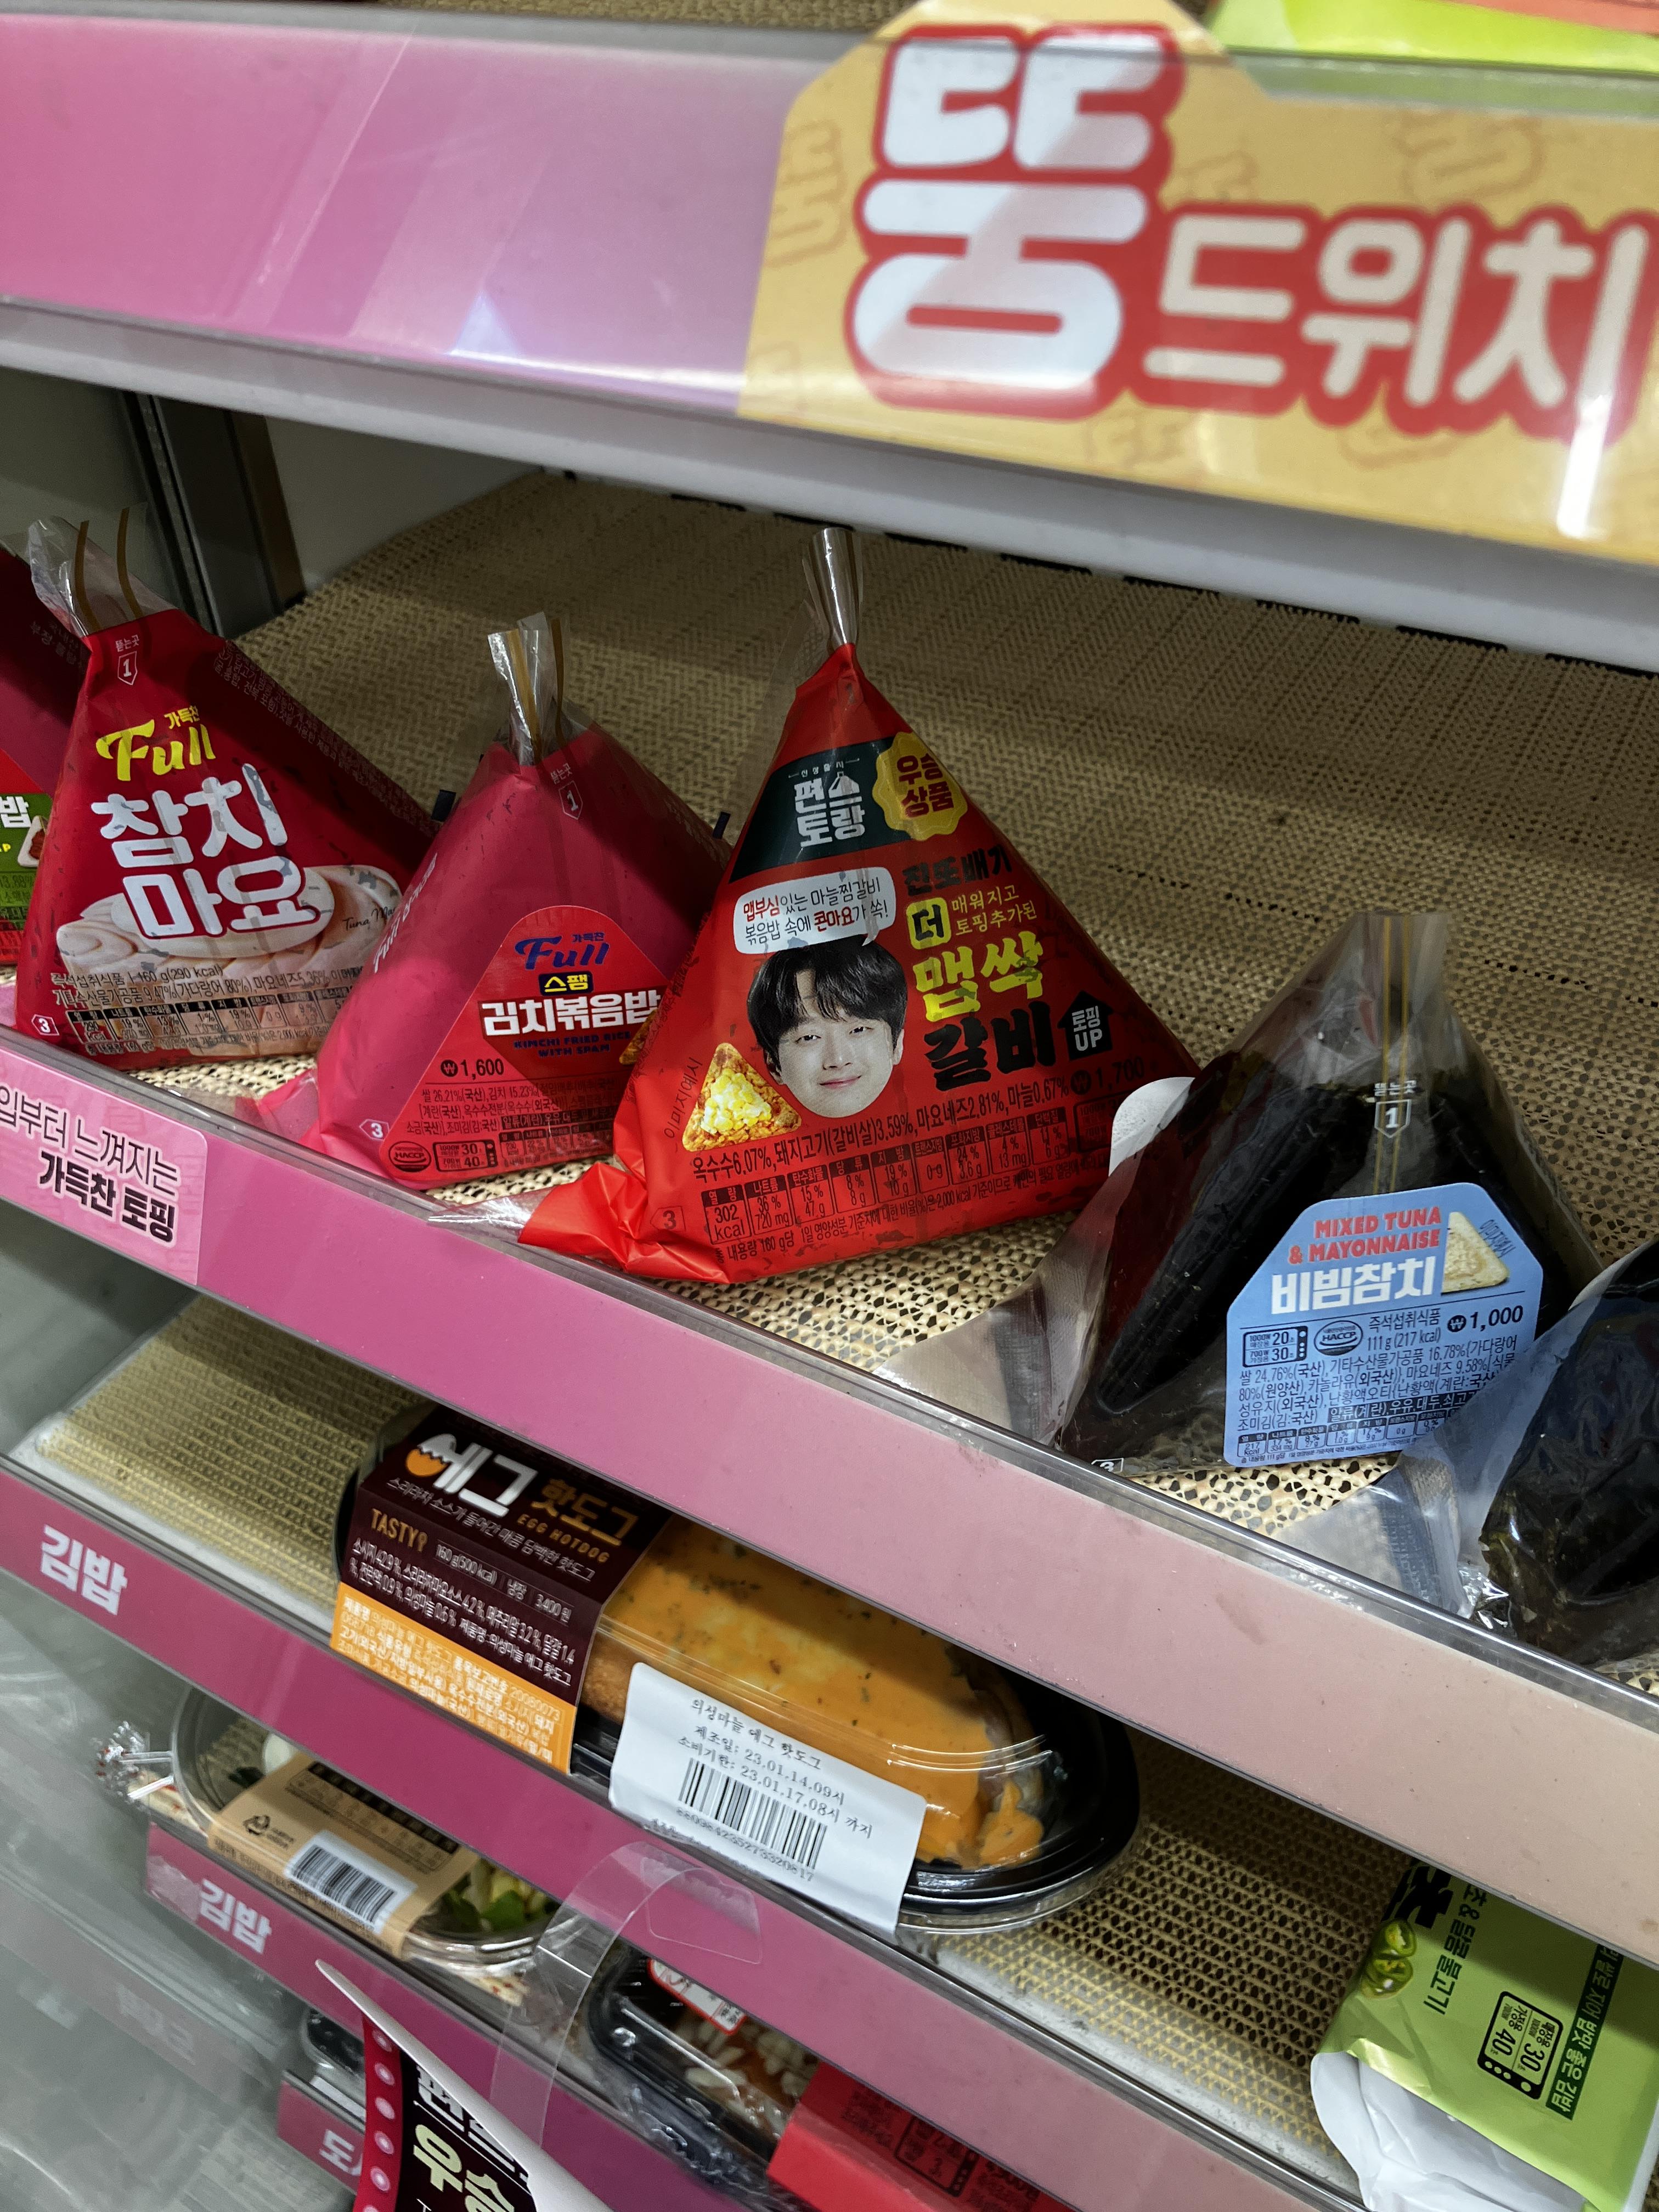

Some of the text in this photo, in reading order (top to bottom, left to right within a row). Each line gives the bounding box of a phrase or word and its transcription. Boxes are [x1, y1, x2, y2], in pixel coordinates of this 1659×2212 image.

[852, 32, 1647, 407] 뚱드위치
[115, 634, 139, 652] 뜯는곳
[123, 659, 132, 677] 1
[165, 706, 200, 729] 가득찬
[96, 719, 216, 782] Full
[0, 796, 32, 828] 밥
[91, 763, 288, 868] 참치
[567, 790, 579, 812] 1
[901, 782, 956, 819] 상품
[123, 855, 315, 935] 마요
[810, 877, 881, 906] 마늘찜갈비
[342, 917, 370, 930] Tuna
[745, 899, 888, 946] 볶음밥 속에 콘마요가 쏙!
[912, 905, 945, 941] 더
[515, 935, 610, 970] Full
[544, 974, 589, 992] 스팸
[912, 930, 1043, 1023] 맵싹
[38, 1018, 50, 1034] 3
[482, 989, 661, 1036] 김치볶음밥
[1071, 1005, 1101, 1033] 토핑
[514, 1030, 631, 1049] KIMCHI FRIED RICE
[538, 1043, 611, 1058] WITH SPAM
[924, 1001, 1057, 1092] 갈비
[1074, 1028, 1103, 1052] UP
[663, 1057, 703, 1139] 이미지예시
[371, 1122, 383, 1138] 3
[1385, 1107, 1399, 1128] 1
[75, 1118, 178, 1196] 느껴지는
[461, 1143, 478, 1155] 30
[464, 1156, 481, 1167] 40
[39, 1149, 174, 1244] 가득찬 토핑
[662, 1210, 676, 1231] 3
[714, 1204, 740, 1224] 302
[715, 1219, 745, 1242] kcal
[1314, 1206, 1442, 1239] MIXED TUNA
[727, 1242, 757, 1262] 내용량
[814, 1220, 848, 1241] 영양성분
[1288, 1229, 1441, 1265] & MAYONNAISE
[1271, 1256, 1437, 1314] 비빔참치
[1322, 1331, 1356, 1341] HACCP
[1368, 1308, 1441, 1333] 즉석섭취식품
[1419, 1327, 1442, 1344] kcal)
[1271, 1347, 1289, 1362] 30
[1272, 1331, 1289, 1345] 20
[1239, 1370, 1251, 1386] 쌀
[1331, 1348, 1424, 1373] 기타수산물가공품
[1406, 1361, 1452, 1381] 마요네즈
[405, 1433, 640, 1547] 에그 핫도그
[370, 1508, 419, 1548] TASTY
[516, 1513, 611, 1564] EGG HOTDOG
[40, 1523, 128, 1616] 김밥
[691, 1699, 823, 1770] 의성마늘 에그 핫도그
[745, 1749, 845, 1806] 23.01.14.09시
[740, 1765, 840, 1824] 23.01.17.08시
[846, 1816, 874, 1840] 까지
[199, 1878, 273, 1955] 김밥
[1423, 1954, 1463, 2015] 불고기
[1492, 2005, 1528, 2056] 가정용 40
[1571, 2019, 1598, 2051] 밥맛
[1520, 2042, 1545, 2072] 30
[1561, 2047, 1587, 2081] 좋은
[1550, 2081, 1578, 2114] 김밥
